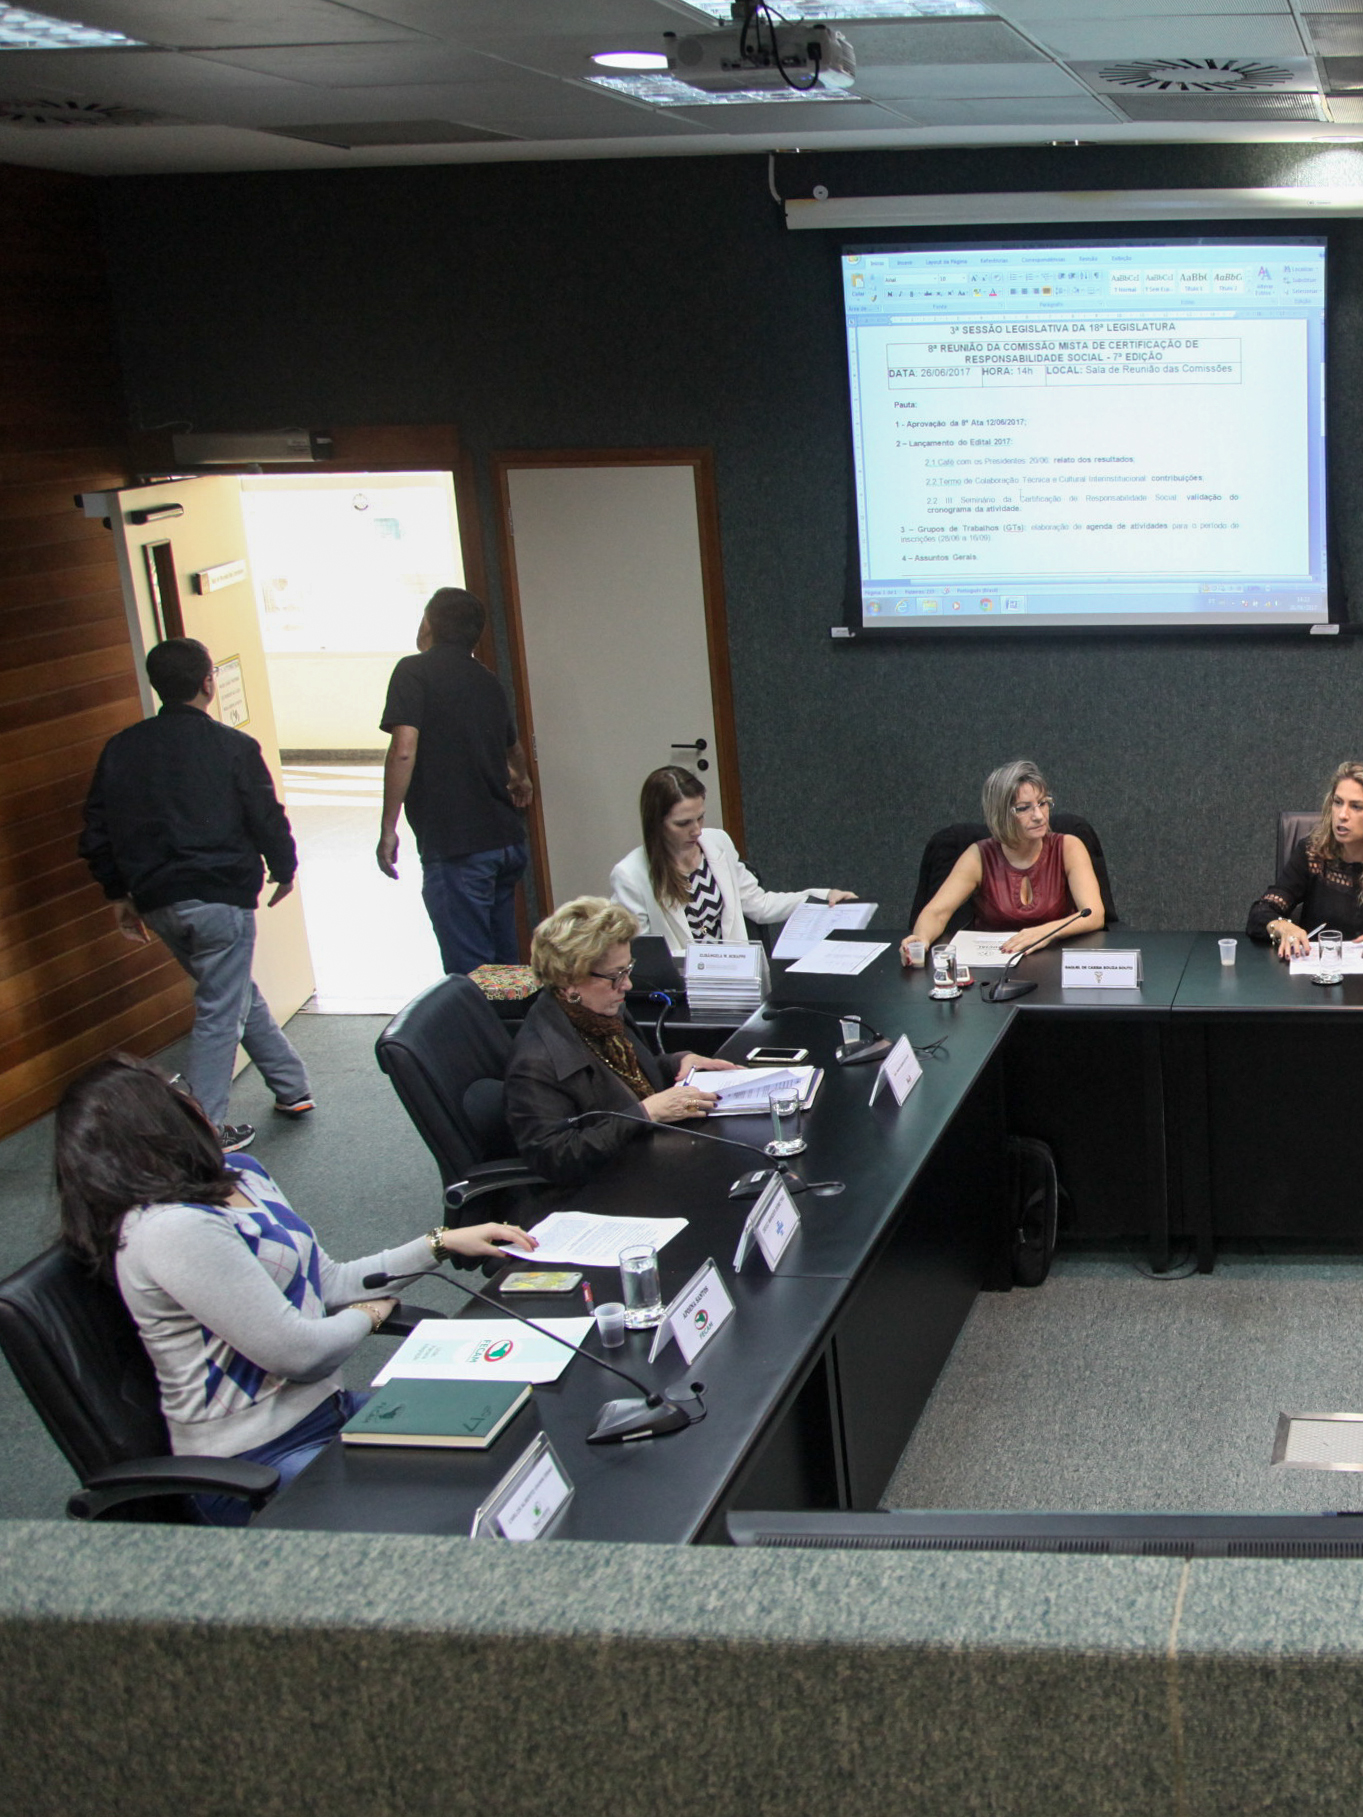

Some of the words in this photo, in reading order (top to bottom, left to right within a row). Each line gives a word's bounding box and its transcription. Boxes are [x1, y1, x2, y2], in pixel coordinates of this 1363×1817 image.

[950, 326, 959, 334] 3ª
[962, 324, 1002, 334] SESSÃO
[1006, 324, 1068, 333] LEGISLATIVA
[1072, 324, 1085, 332] DA
[1089, 324, 1104, 332] 18ª
[1106, 322, 1176, 332] LEGISLATURA
[928, 344, 937, 352] 8ª
[940, 342, 983, 352] REUNIÃO
[987, 343, 1000, 351] DA
[1003, 341, 1055, 351] COMISSÃO
[1058, 341, 1088, 350] MISTA
[1092, 341, 1105, 349] DE
[1108, 339, 1182, 350] CERTIFICAÇÃO
[1185, 340, 1198, 348] DE
[965, 354, 1064, 363] RESPONSABILIDADE
[1067, 353, 1103, 362] SOCIAL
[1113, 353, 1122, 361] 7ª
[1126, 351, 1162, 362] EDIÇÃO
[889, 369, 918, 378] DATA:
[920, 368, 970, 377] 26/06/2017
[982, 367, 1013, 376] HORA:
[1017, 367, 1033, 375] 14h
[1046, 366, 1082, 374] LOCAL:
[1086, 365, 1106, 374] Sala
[1109, 365, 1119, 373] de
[1123, 364, 1160, 373] Reunião
[1162, 364, 1179, 372] das
[1182, 363, 1232, 372] Comissões
[907, 420, 946, 428] Aprovação
[909, 440, 954, 448] Lançamento
[970, 438, 991, 446] Edital
[938, 458, 954, 466] Café
[1054, 456, 1075, 464] relato
[975, 477, 1019, 485] Colaboração
[1086, 494, 1147, 502] Responsabilidade
[1187, 494, 1222, 502] validação
[962, 524, 999, 532] Trabalhos
[1031, 524, 1069, 532] elaboração
[699, 1322, 714, 1339] FECAM
[468, 1339, 492, 1363] FECAM
